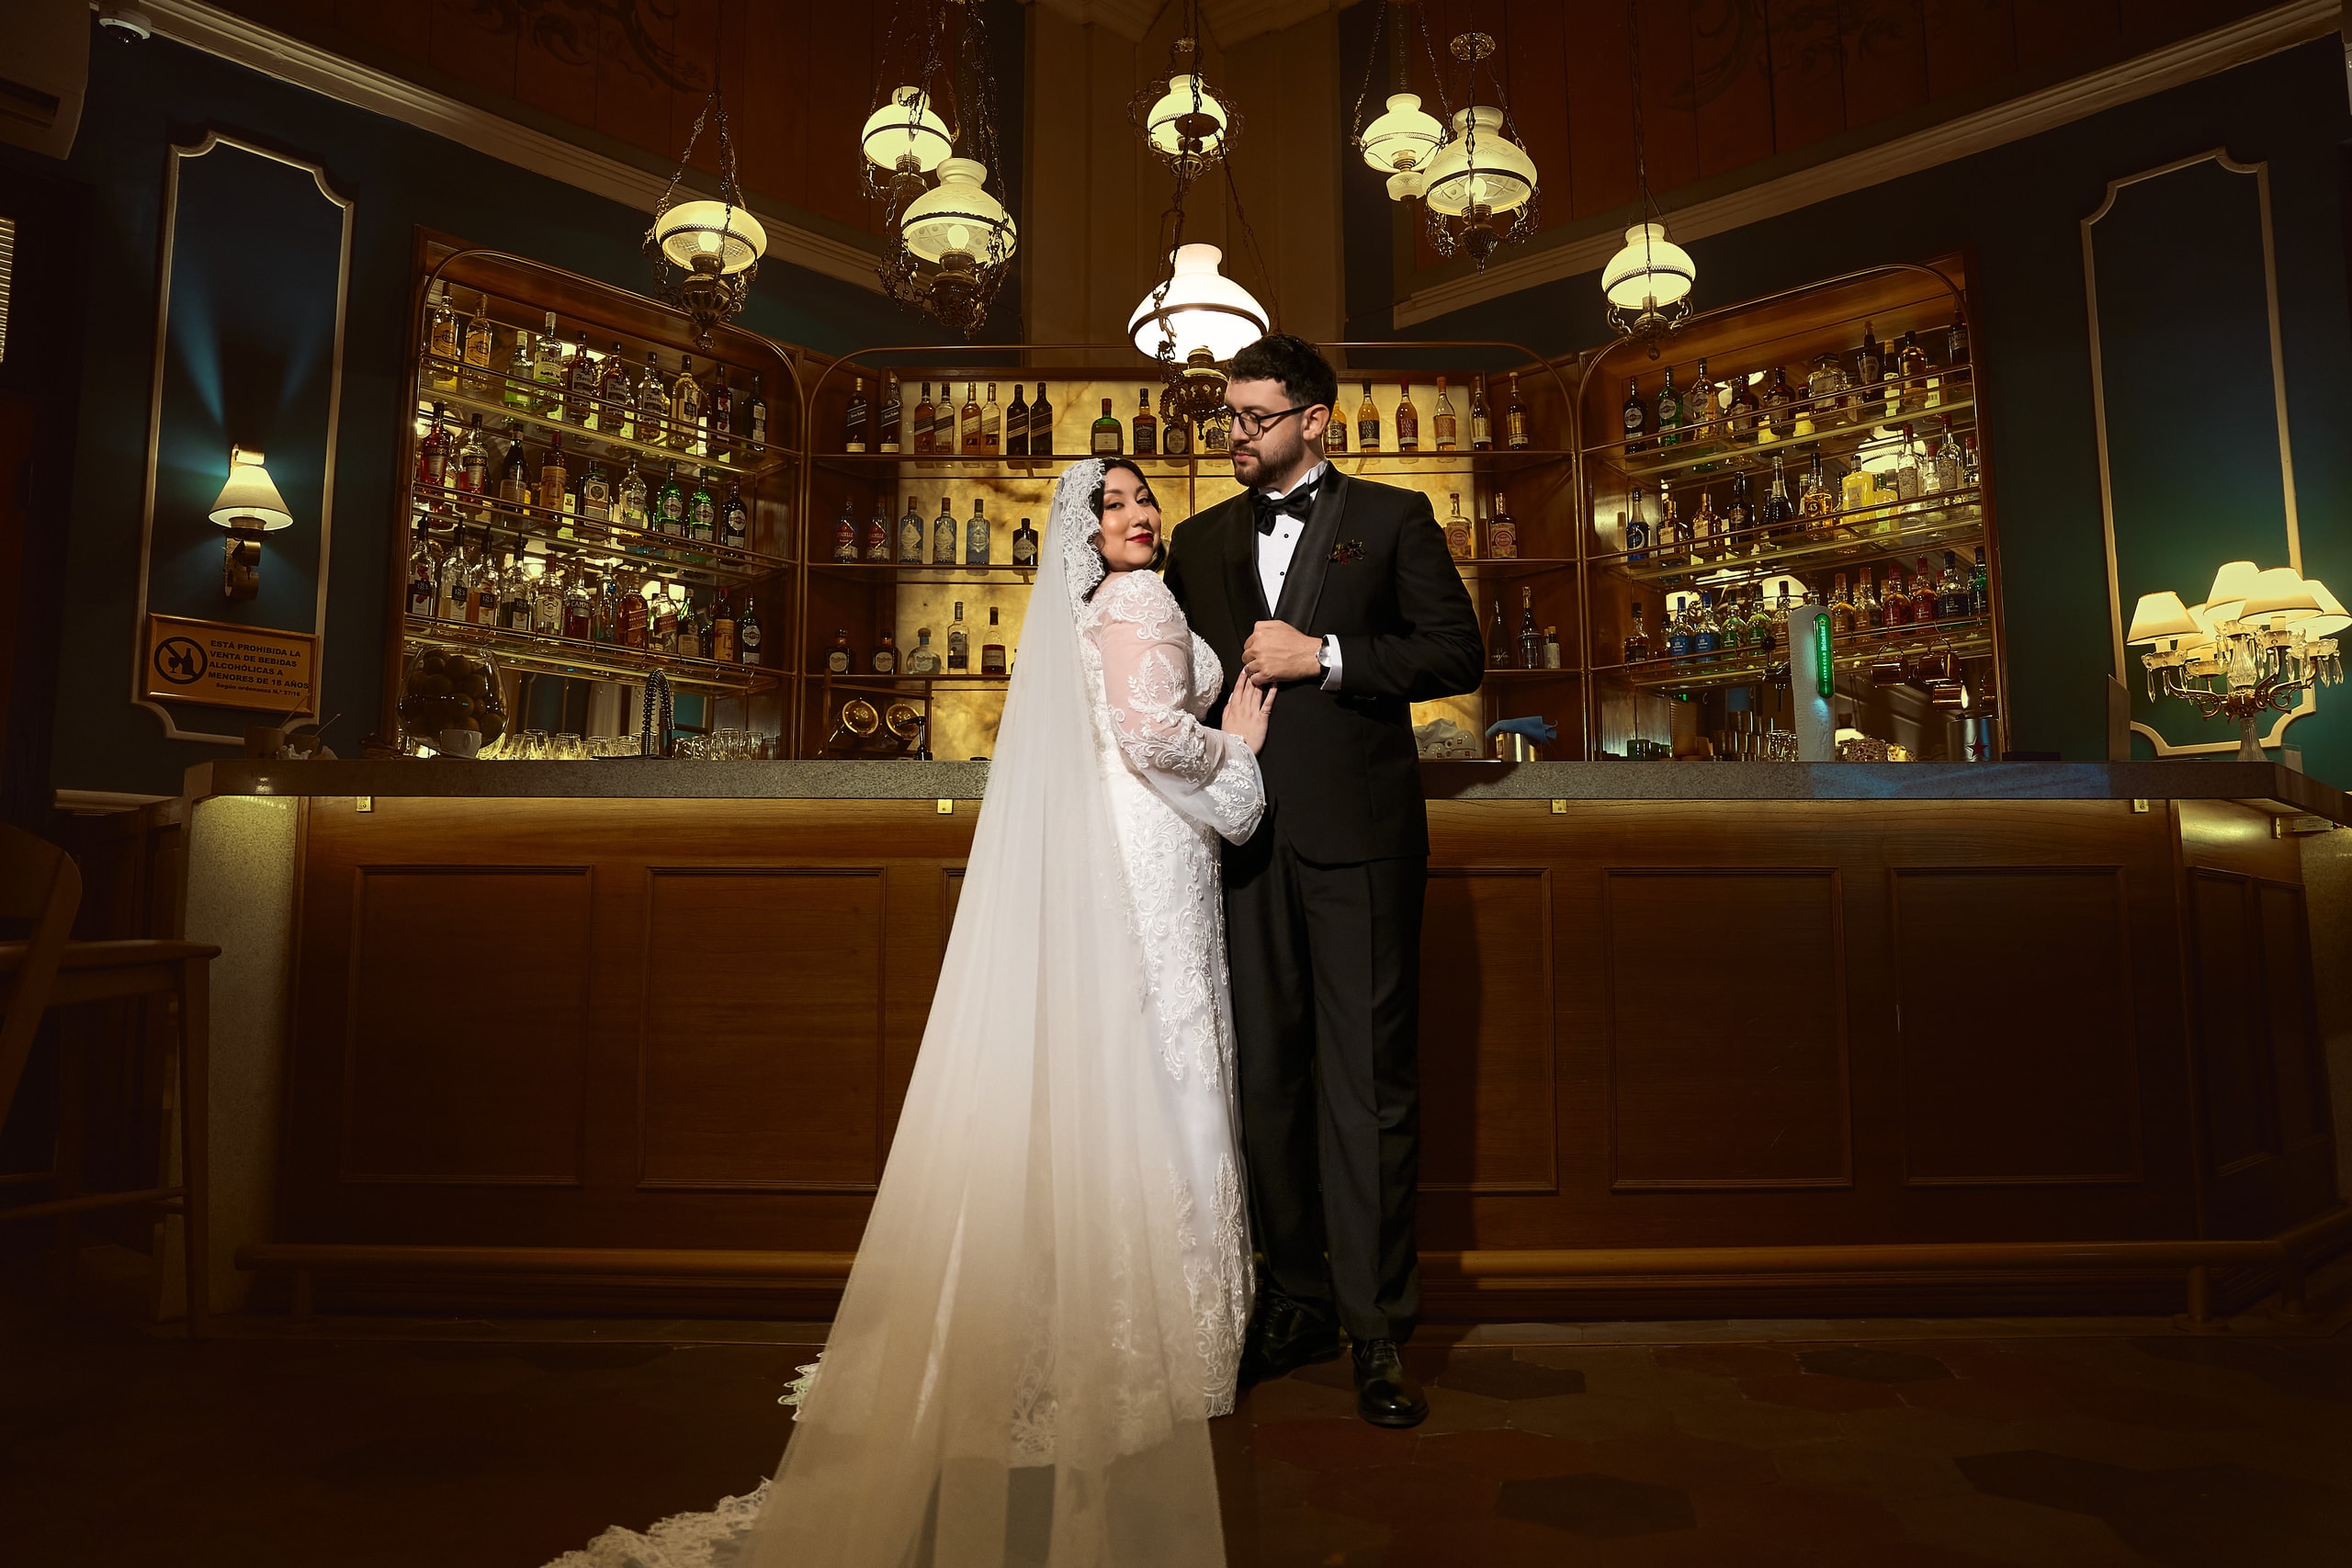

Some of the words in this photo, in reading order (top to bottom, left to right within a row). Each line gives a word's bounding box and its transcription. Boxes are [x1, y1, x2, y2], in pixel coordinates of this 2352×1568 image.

[1808, 502, 1818, 512] 43
[210, 640, 235, 649] ESTÁ
[237, 643, 288, 656] PROHIBIDA
[289, 649, 301, 658] LA
[209, 650, 241, 660] VENTA
[258, 657, 298, 668] BEBIDAS
[209, 661, 275, 675] ALCOHÓLICAS
[209, 671, 254, 683] MENORES
[284, 680, 310, 689] AÑOS
